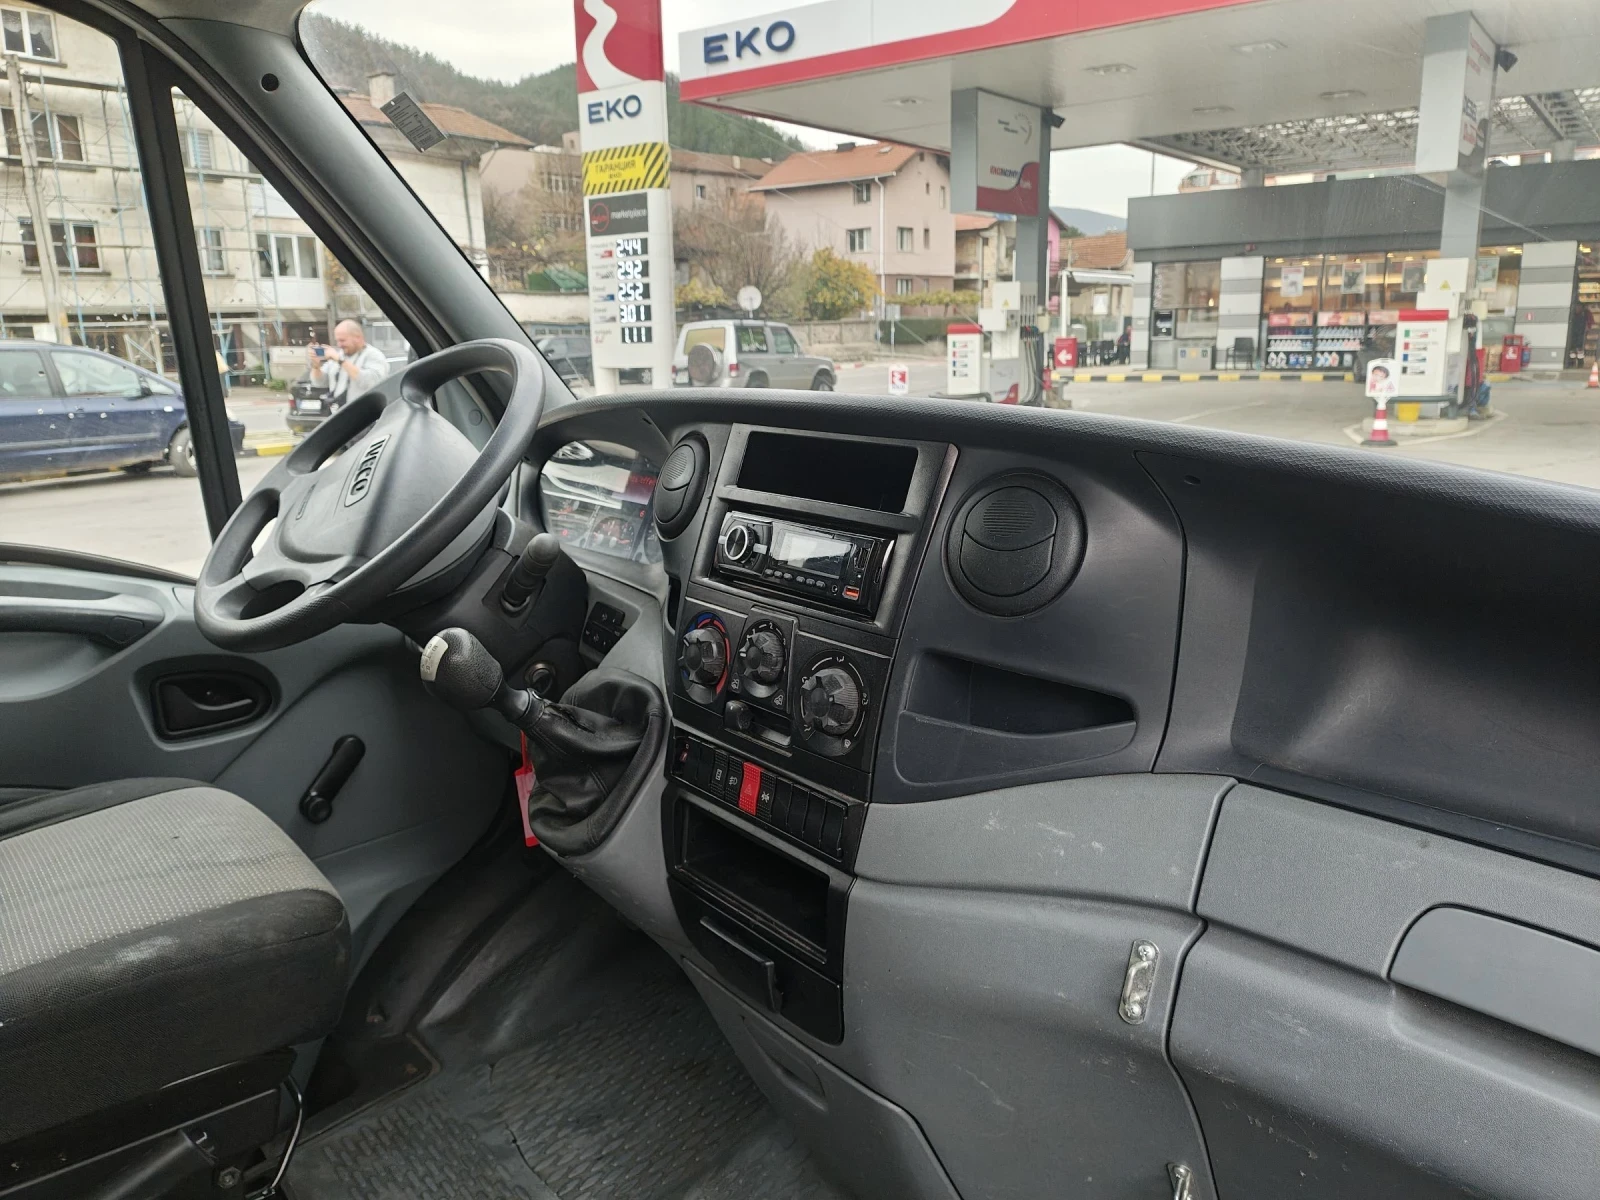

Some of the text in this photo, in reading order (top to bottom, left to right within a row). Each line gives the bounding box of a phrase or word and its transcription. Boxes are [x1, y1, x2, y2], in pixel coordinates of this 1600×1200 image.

[704, 20, 796, 64] EKO
[587, 94, 642, 124] EKO
[350, 439, 386, 495] IVECO
